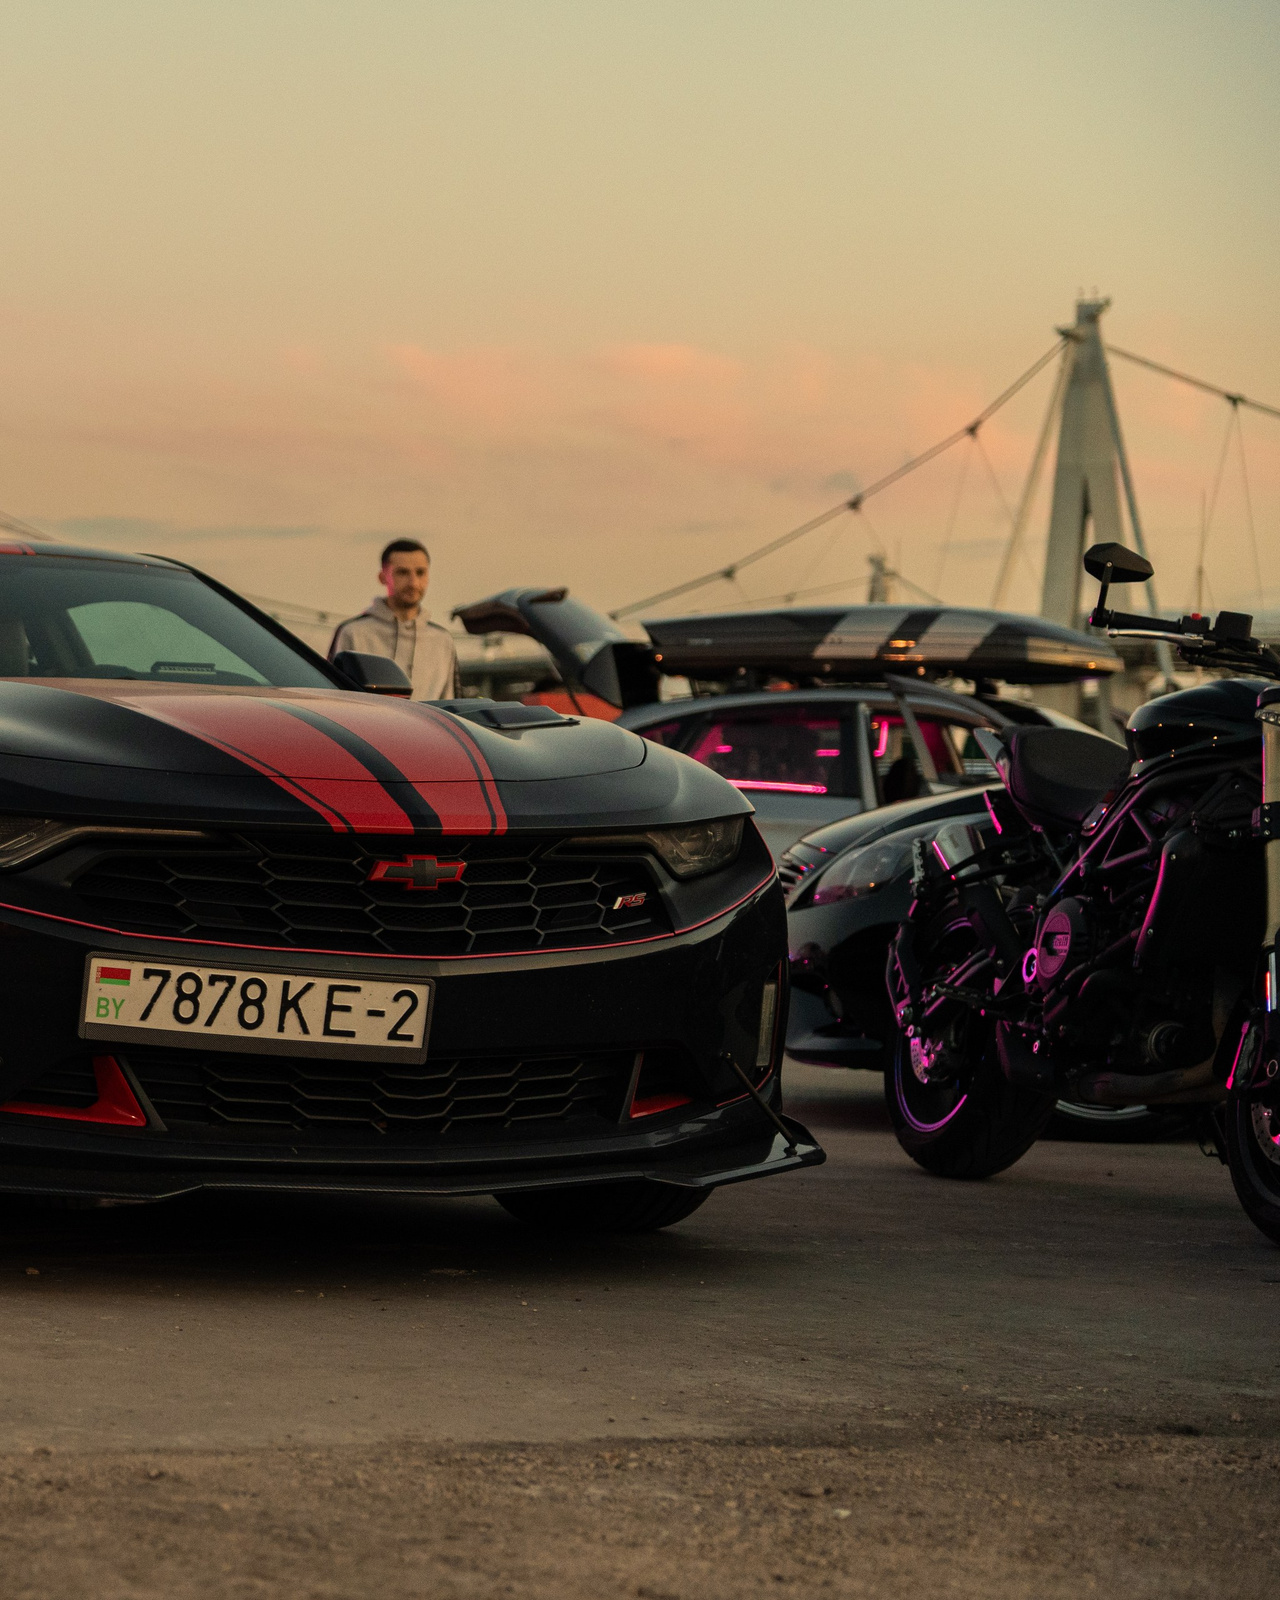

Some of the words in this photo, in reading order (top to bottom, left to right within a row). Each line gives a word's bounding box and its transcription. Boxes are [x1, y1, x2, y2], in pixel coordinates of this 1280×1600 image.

[613, 892, 647, 910] RS
[95, 996, 126, 1020] BY
[139, 967, 420, 1042] 7878KE-2
